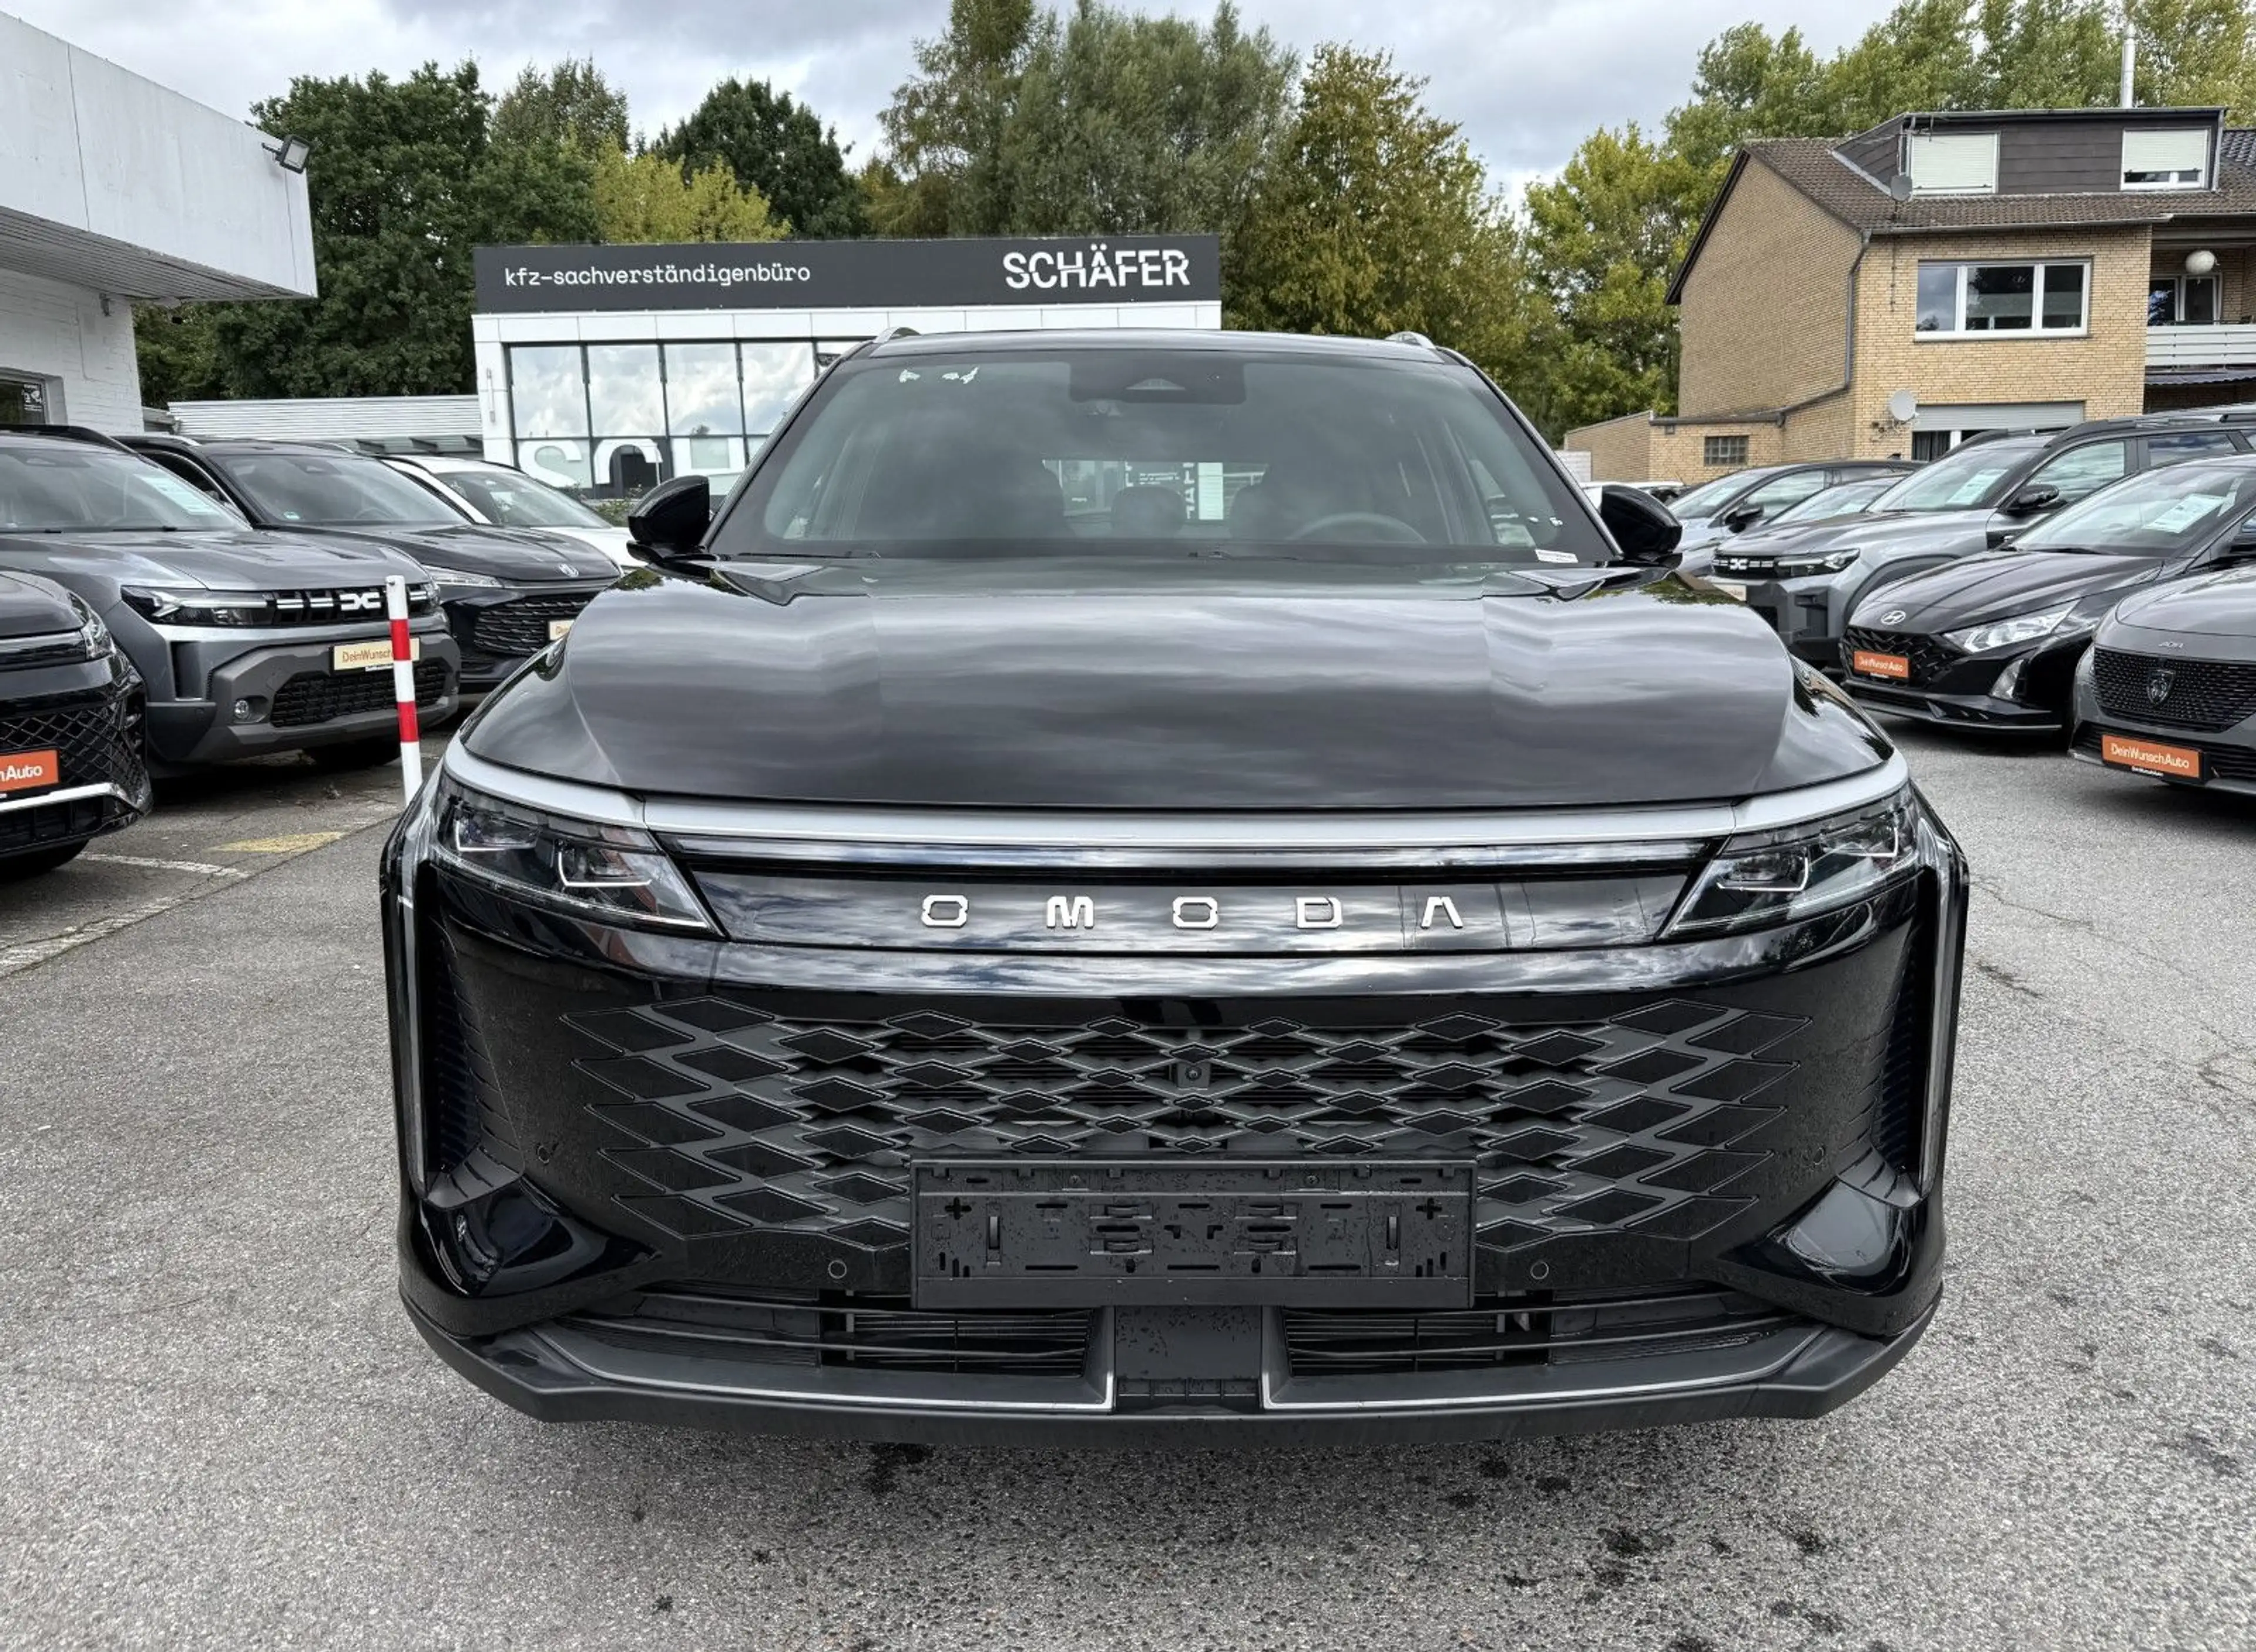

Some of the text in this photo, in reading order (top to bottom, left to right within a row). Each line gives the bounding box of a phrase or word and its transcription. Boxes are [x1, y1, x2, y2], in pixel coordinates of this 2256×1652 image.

[505, 263, 810, 286] kfz-sachverständigenbüro
[1003, 243, 1190, 288] SCHÄFER
[2110, 743, 2190, 769] DeinWunschAuto
[921, 895, 1464, 928] OMODA
